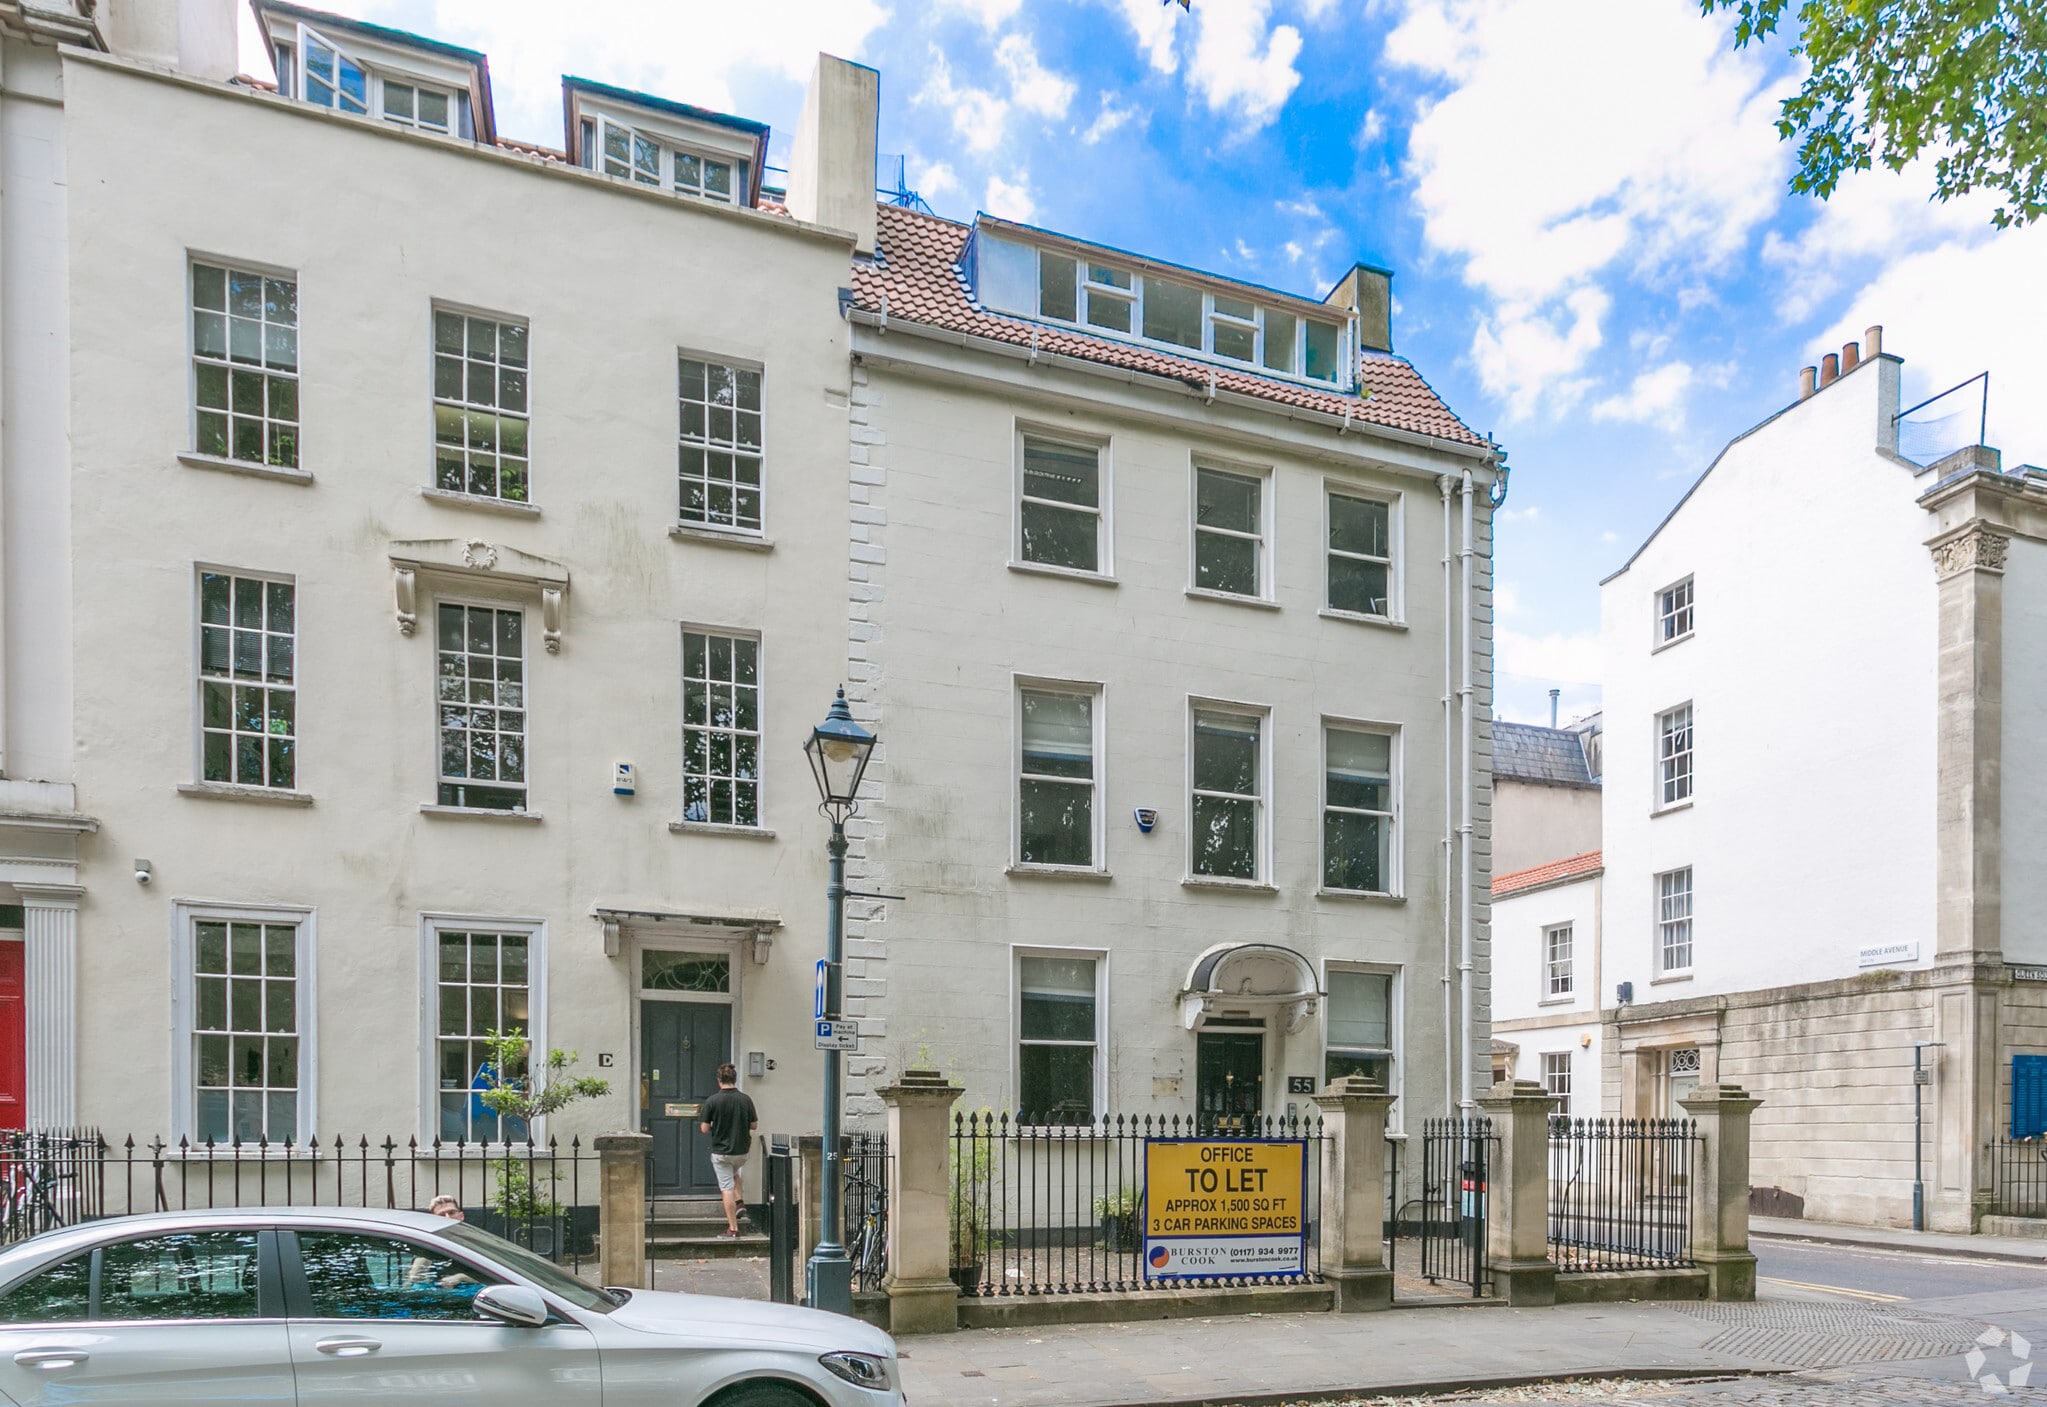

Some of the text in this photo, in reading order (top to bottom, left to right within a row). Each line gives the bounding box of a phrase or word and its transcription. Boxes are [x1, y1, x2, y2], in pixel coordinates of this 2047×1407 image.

[1860, 945, 1908, 957] MIDDLE AVENUE
[821, 1024, 830, 1035] P
[1294, 1079, 1311, 1092] 55
[826, 1151, 838, 1161] 25
[1201, 1147, 1253, 1162] OFFICE
[1185, 1168, 1268, 1193] TO LET
[1165, 1198, 1286, 1214] APPROX 1,500 SQ FT
[1153, 1216, 1296, 1231] 3 CAR PARKING SPACES
[1171, 1247, 1227, 1256] BURSTON
[1230, 1247, 1299, 1256] (0117) 934 9977
[1181, 1256, 1216, 1265] COOK
